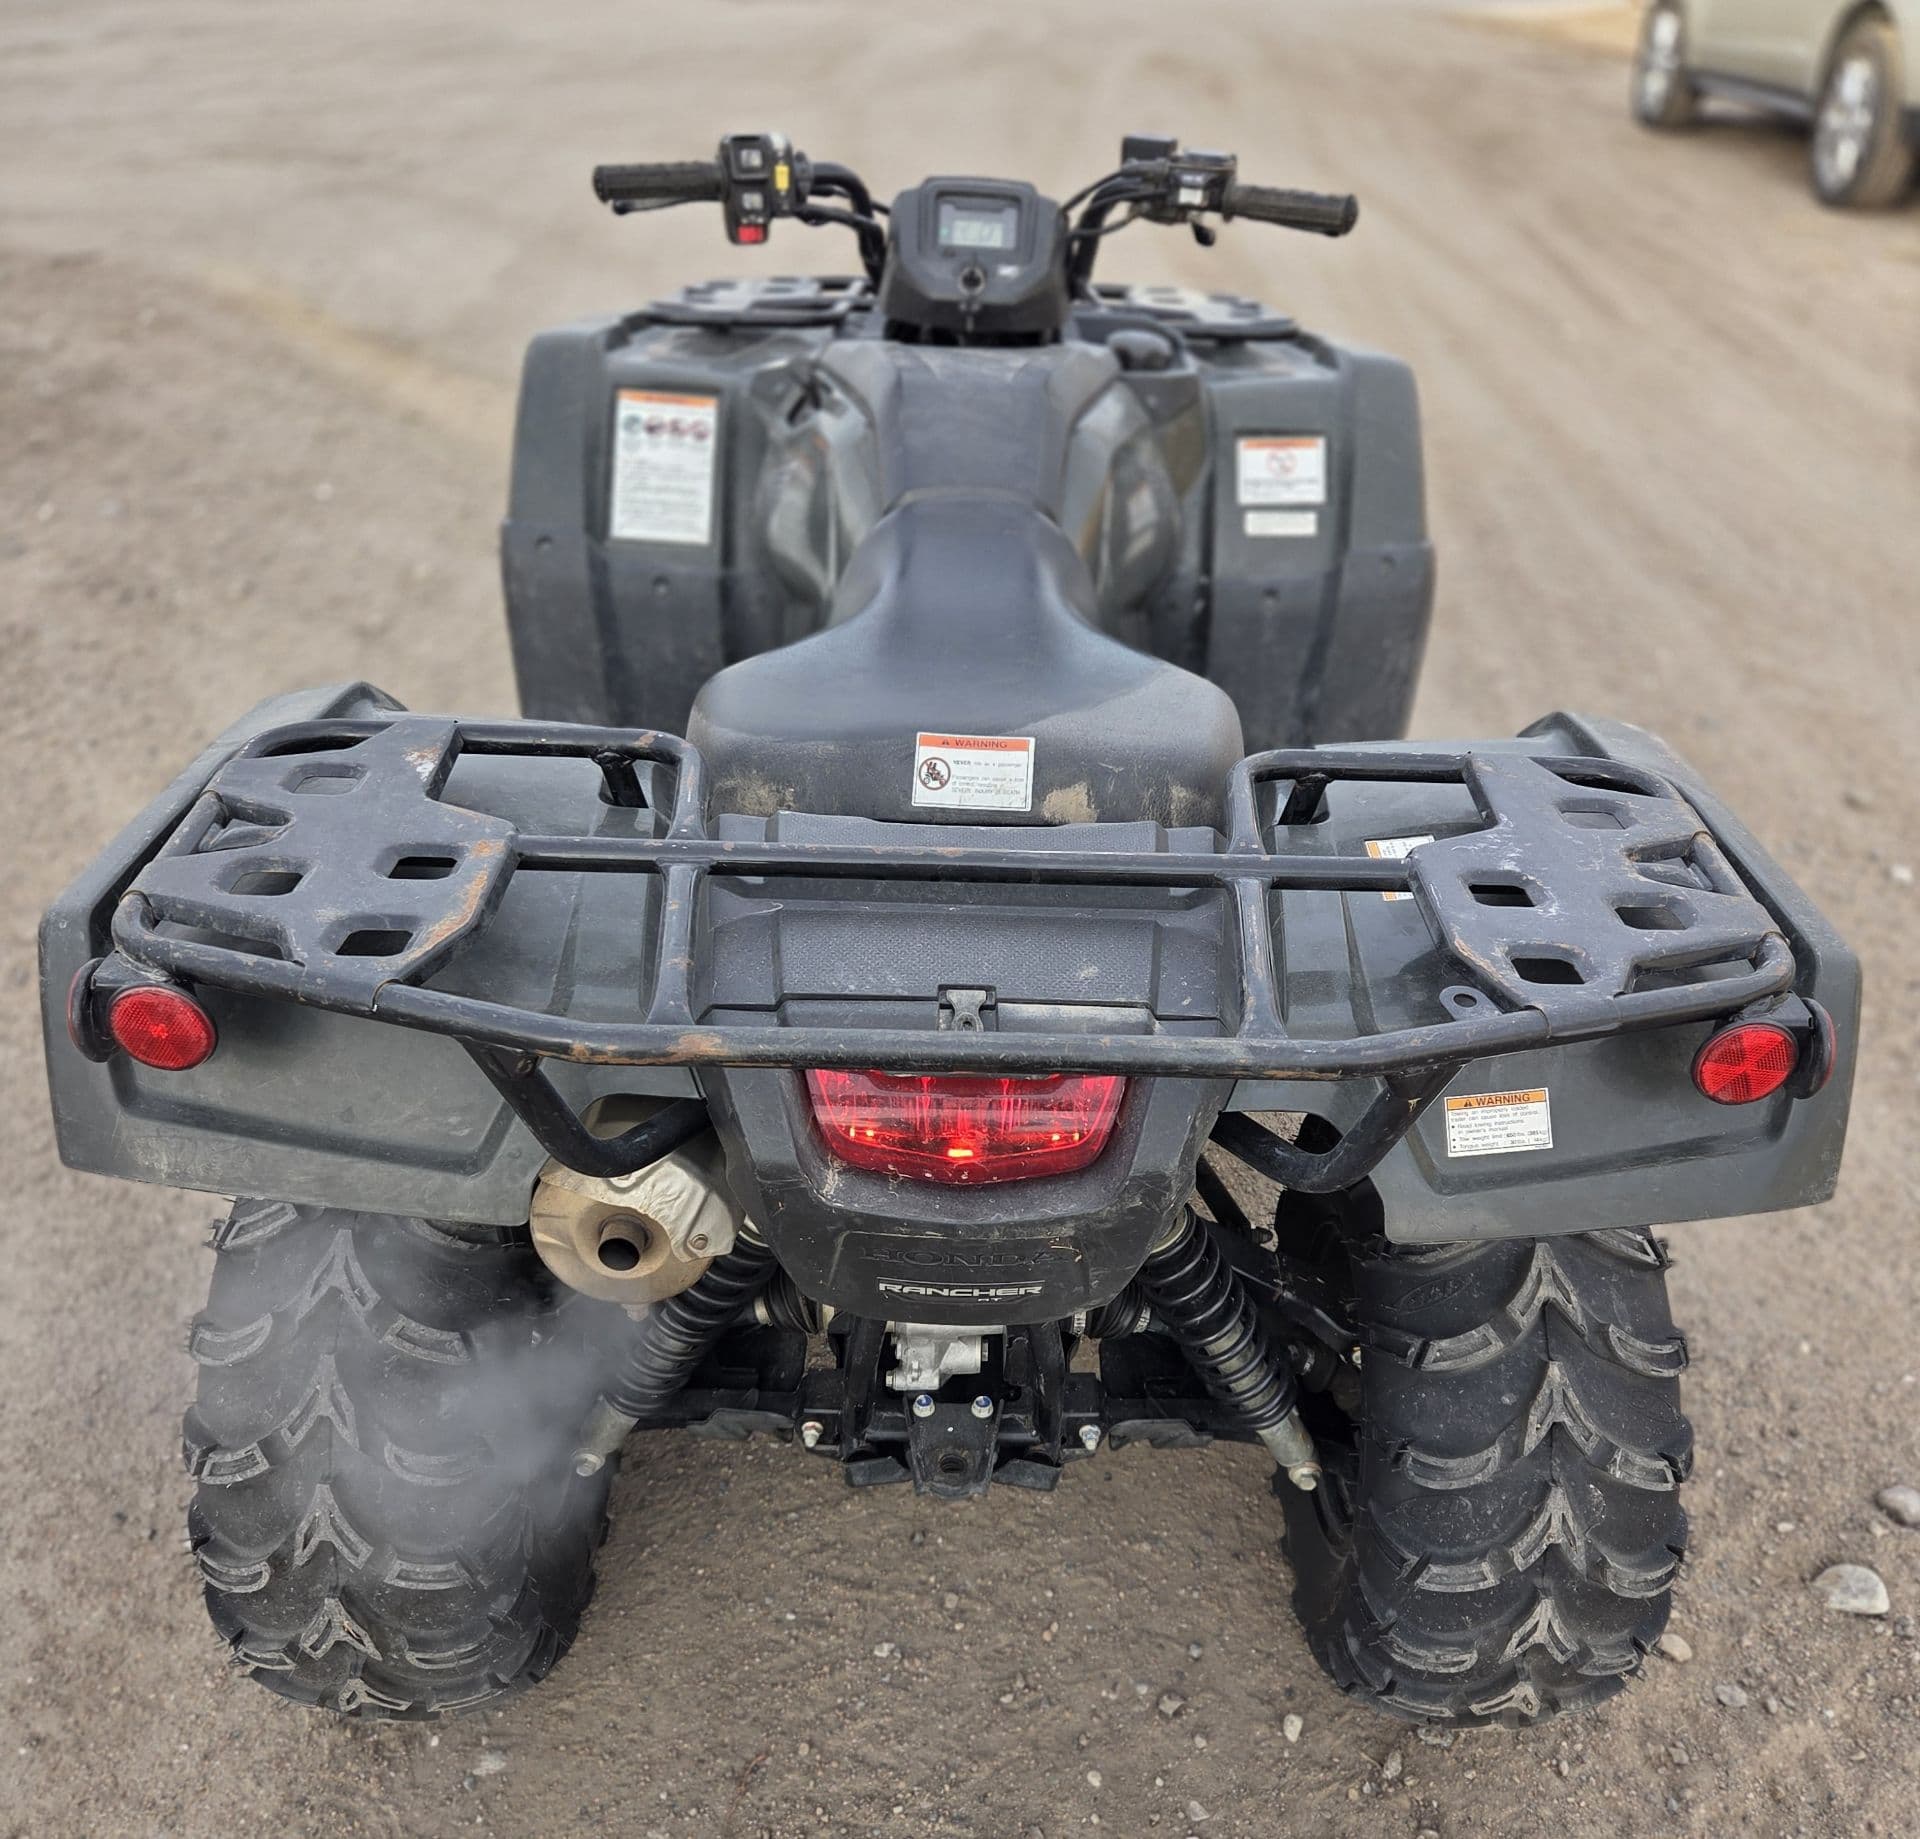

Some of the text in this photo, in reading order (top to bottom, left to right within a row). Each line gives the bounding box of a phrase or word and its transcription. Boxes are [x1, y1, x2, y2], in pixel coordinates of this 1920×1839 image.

[955, 739, 1008, 749] WARNING
[1475, 1093, 1530, 1106] WARNING
[860, 1247, 1066, 1266] HONDA
[879, 1283, 1042, 1297] RANCHER
